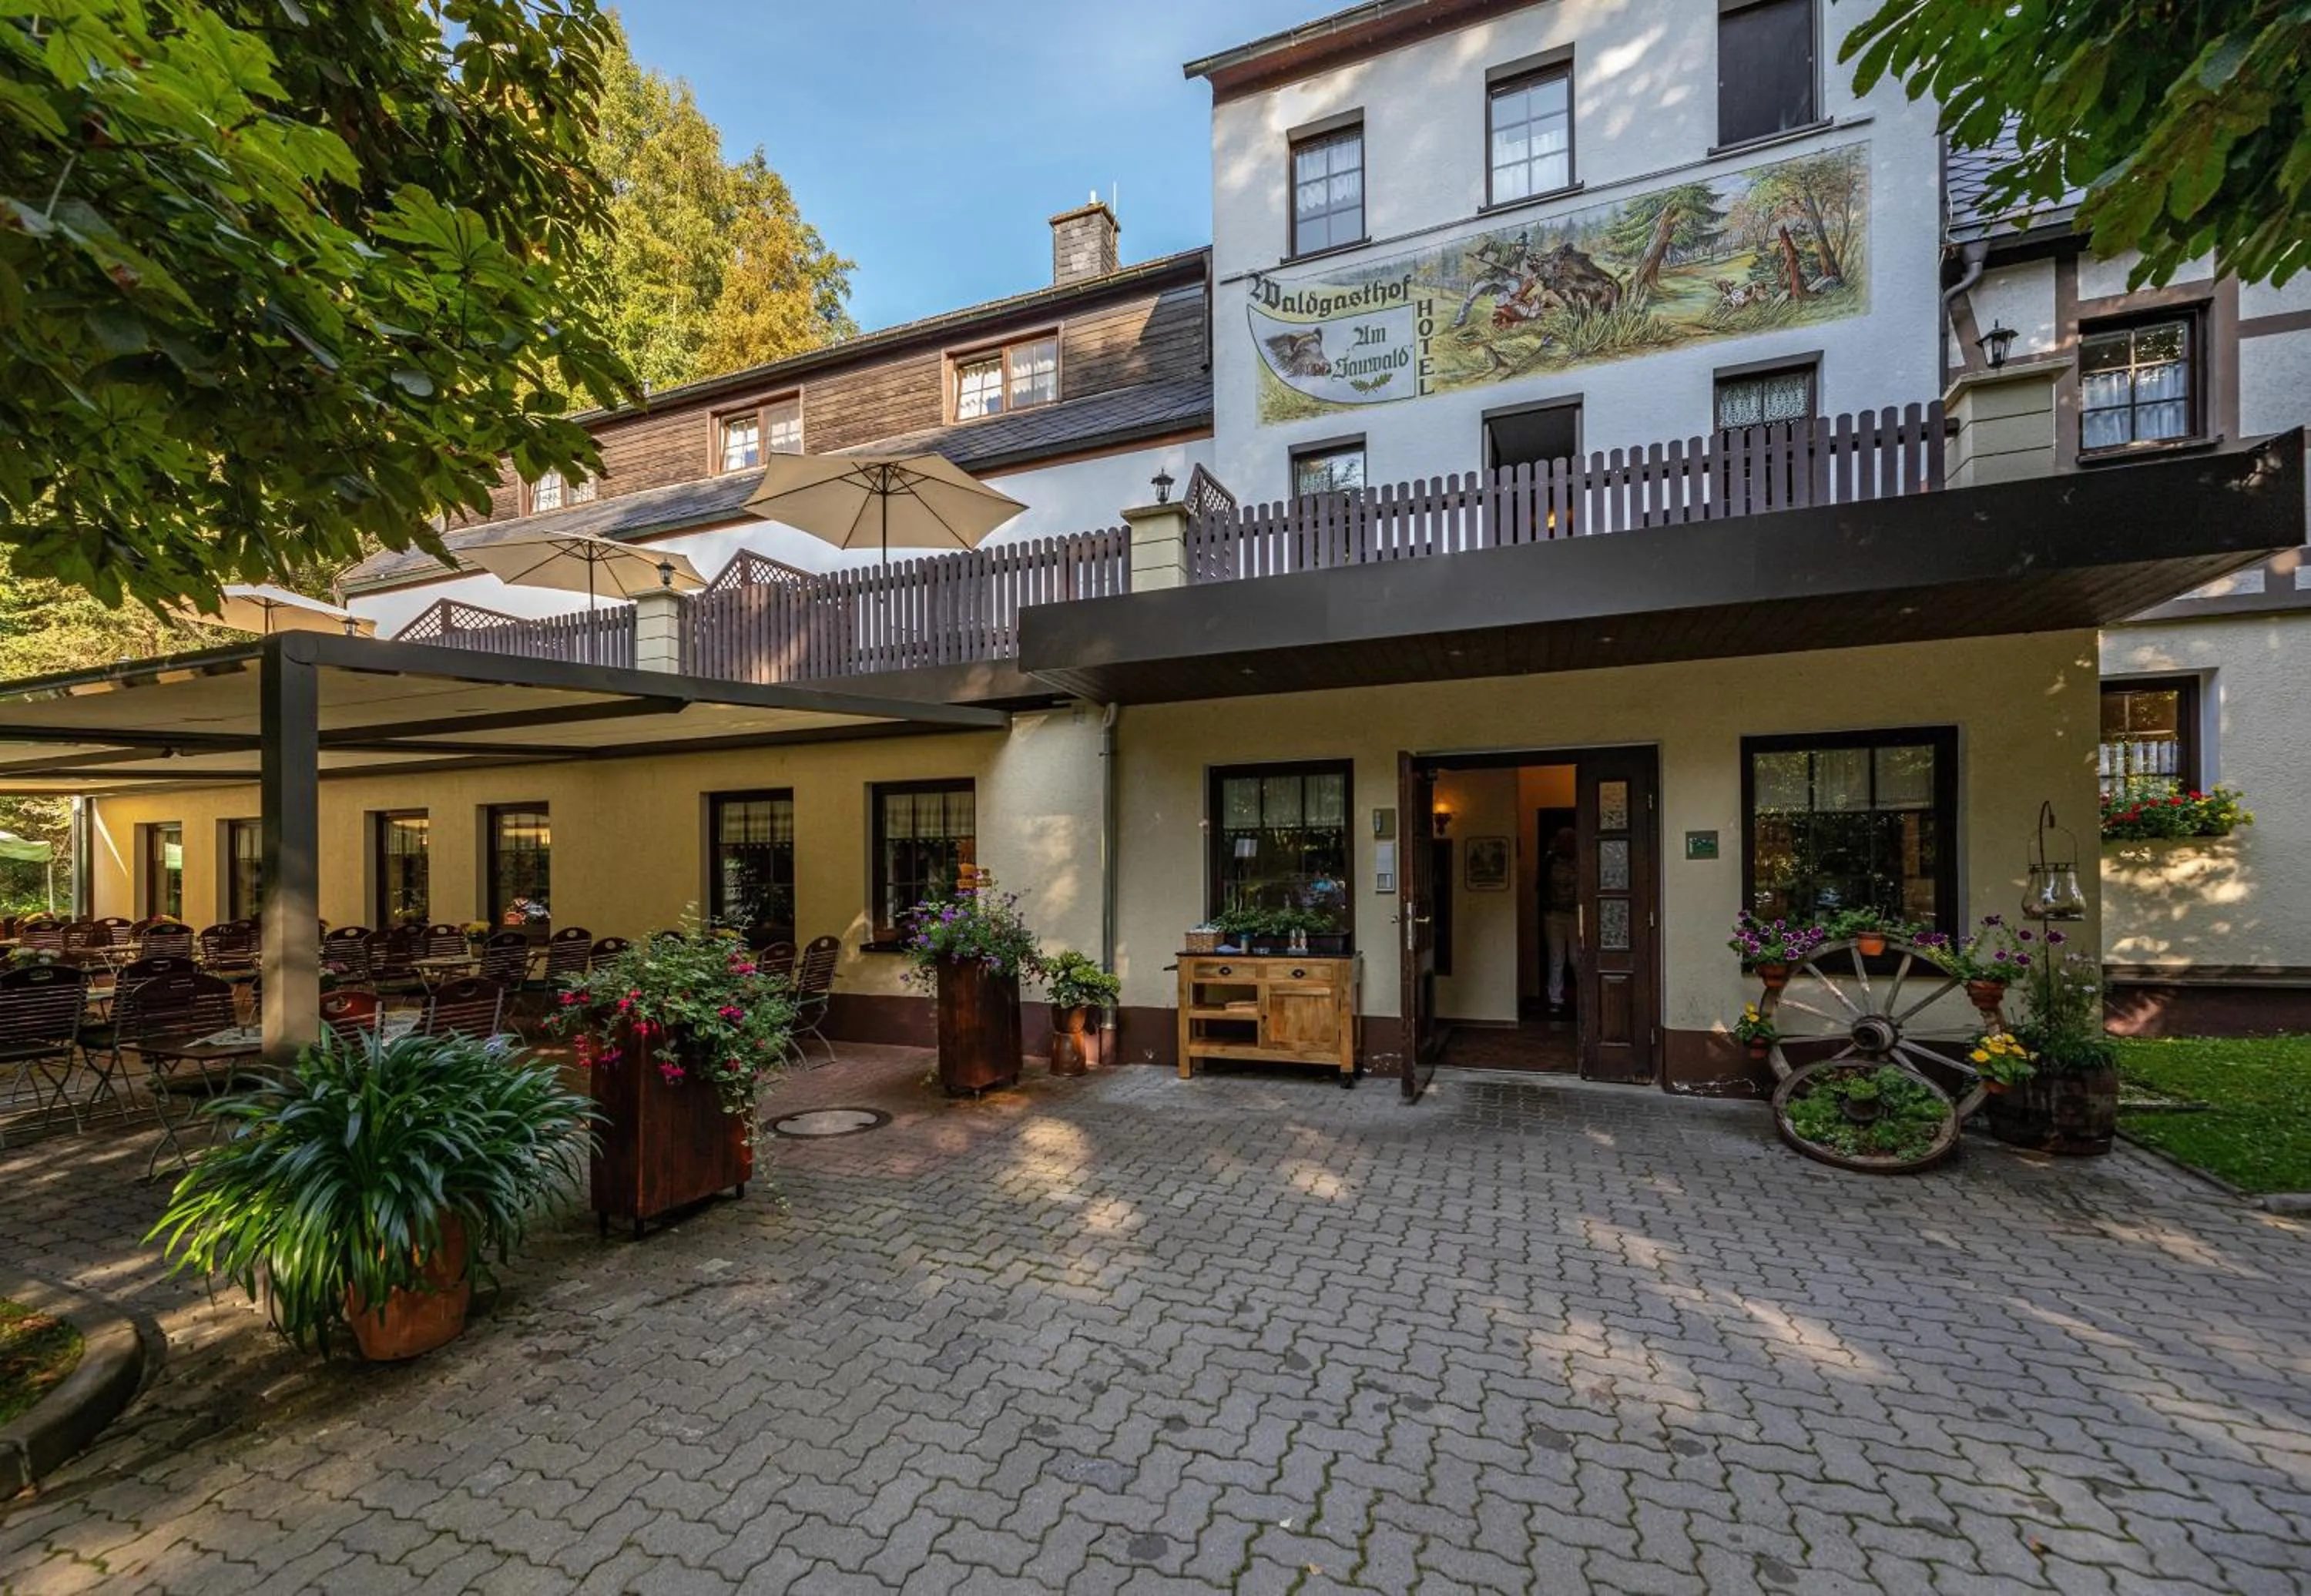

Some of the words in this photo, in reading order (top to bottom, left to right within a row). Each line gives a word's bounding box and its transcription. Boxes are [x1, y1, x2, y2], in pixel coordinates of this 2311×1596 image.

[1249, 273, 1412, 317] Waldgasthof
[1353, 325, 1386, 348] Am
[1418, 298, 1434, 396] HOTEL
